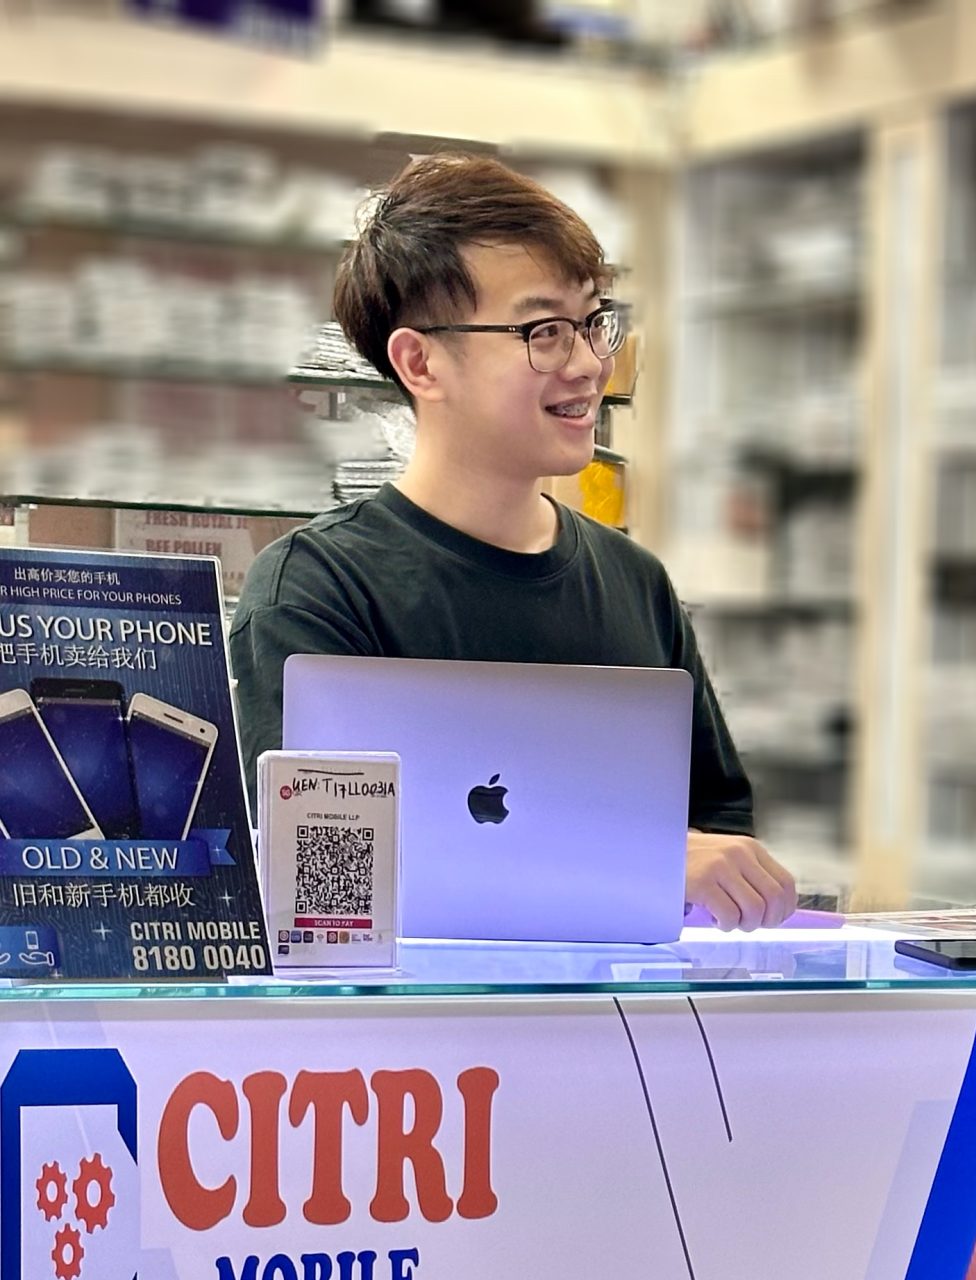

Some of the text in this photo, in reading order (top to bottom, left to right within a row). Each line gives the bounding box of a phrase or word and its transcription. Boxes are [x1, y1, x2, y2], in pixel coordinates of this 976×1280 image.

[14, 566, 120, 586] 出高价买您的手机
[10, 585, 40, 598] HIGH
[43, 587, 75, 600] PRICE
[77, 589, 100, 601] FOR
[102, 590, 134, 603] YOUR
[136, 592, 182, 605] PHONES
[0, 614, 213, 647] US YOUR PHONE
[22, 846, 178, 871] OLD & NEW
[13, 882, 196, 908] 旧和新手机都收
[130, 921, 261, 941] CITRI MOBILE
[133, 945, 266, 971] 8180 0040
[157, 1066, 499, 1232] CITRI
